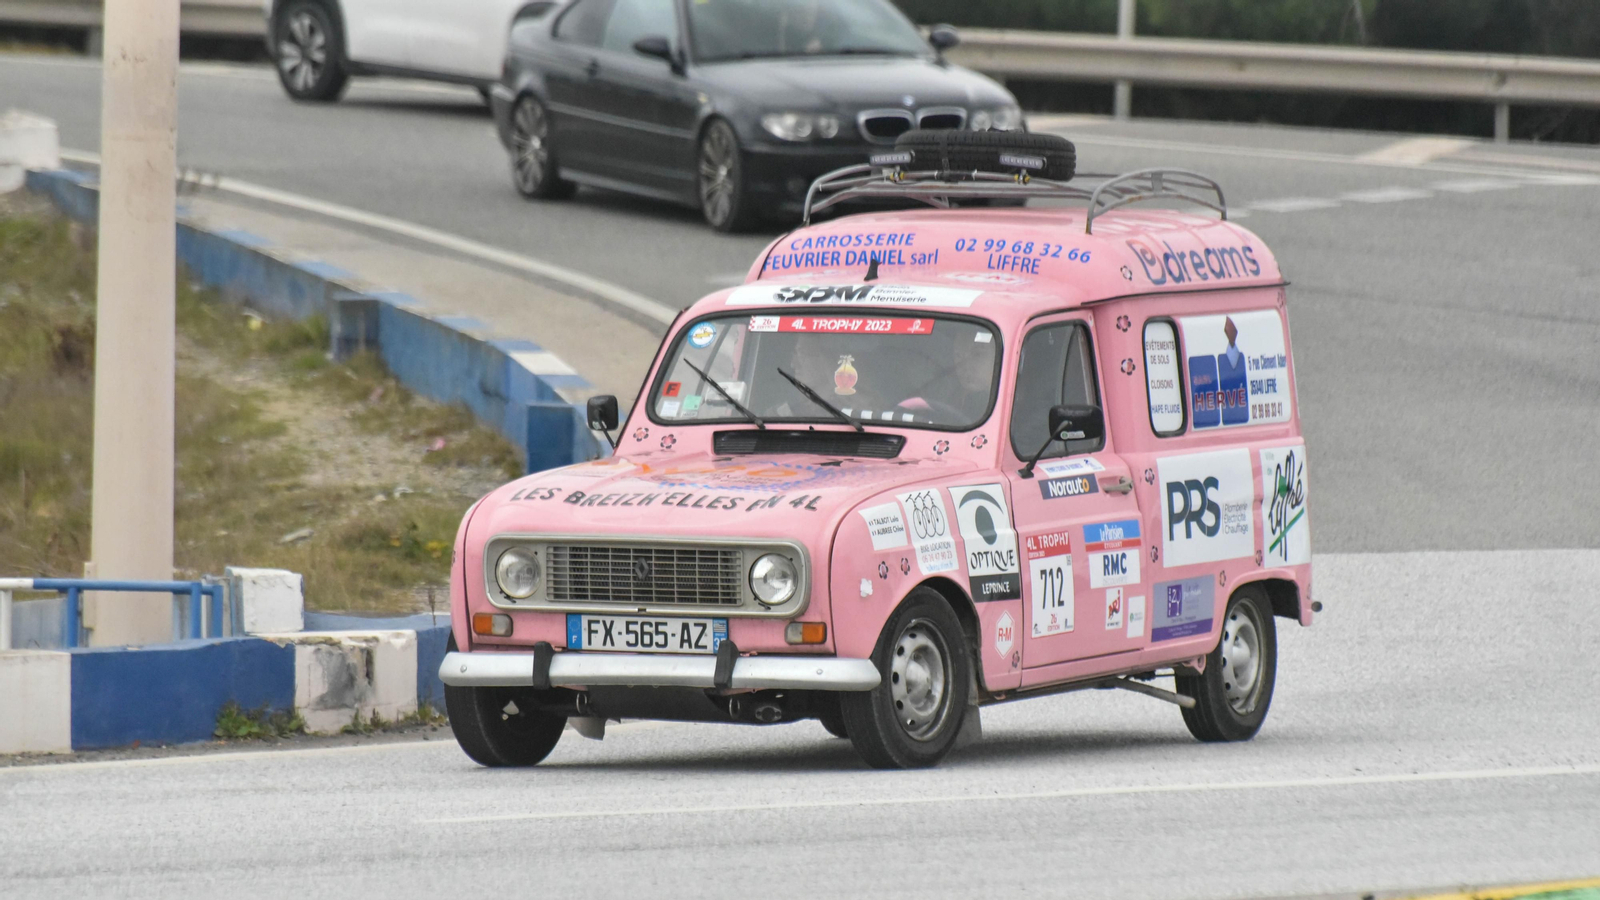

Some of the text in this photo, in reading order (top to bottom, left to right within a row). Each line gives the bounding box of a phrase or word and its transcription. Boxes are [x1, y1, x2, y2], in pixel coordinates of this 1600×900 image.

[791, 233, 916, 251] CARROSSERIE
[955, 238, 1091, 263] 02 99 68 32 66
[763, 249, 939, 271] FEUVRIER DANIEL sarl
[987, 253, 1041, 275] LIFFRE
[870, 295, 927, 303] Menuiserie
[791, 319, 892, 332] 4L TROPHY 2023
[1157, 354, 1170, 365] SOLS
[666, 383, 678, 395] F
[1150, 380, 1174, 389] CLOISONS
[1194, 382, 1247, 412] HERVÉ
[1152, 404, 1164, 414] HAPE
[1048, 477, 1090, 497] Norauto
[510, 487, 562, 502] LES
[563, 490, 744, 510] BREIZH'ELLES
[789, 495, 822, 511] 4L
[1166, 476, 1221, 541] PRS
[1027, 531, 1069, 550] 4L TROPHY
[970, 549, 1016, 571] OPTIQUE
[1103, 552, 1127, 576] RMC
[982, 581, 1010, 595] LEPRINCE
[1040, 566, 1065, 610] 712
[572, 635, 578, 644] F
[587, 619, 708, 650] FX-565-AZ
